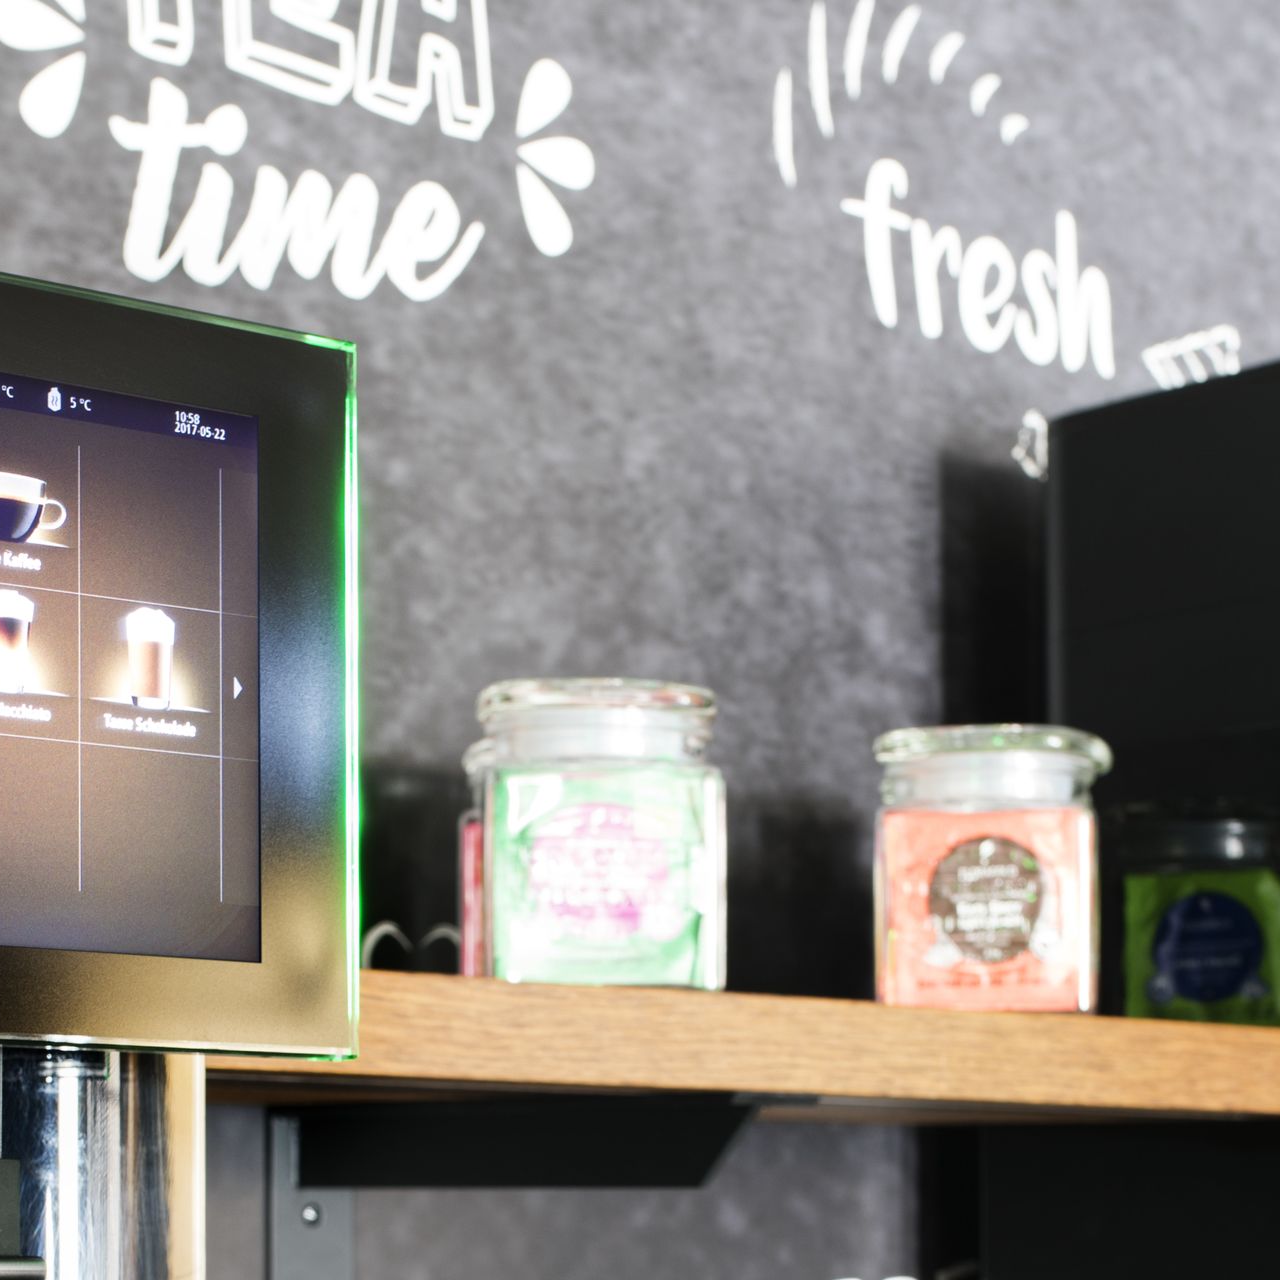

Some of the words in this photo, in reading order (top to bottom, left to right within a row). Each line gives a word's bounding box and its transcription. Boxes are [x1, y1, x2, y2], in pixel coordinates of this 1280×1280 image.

[107, 76, 486, 301] time
[839, 157, 1116, 380] fresh
[70, 396, 78, 409] 5
[174, 410, 201, 425] 10:58
[174, 421, 226, 441] 2017-05-22
